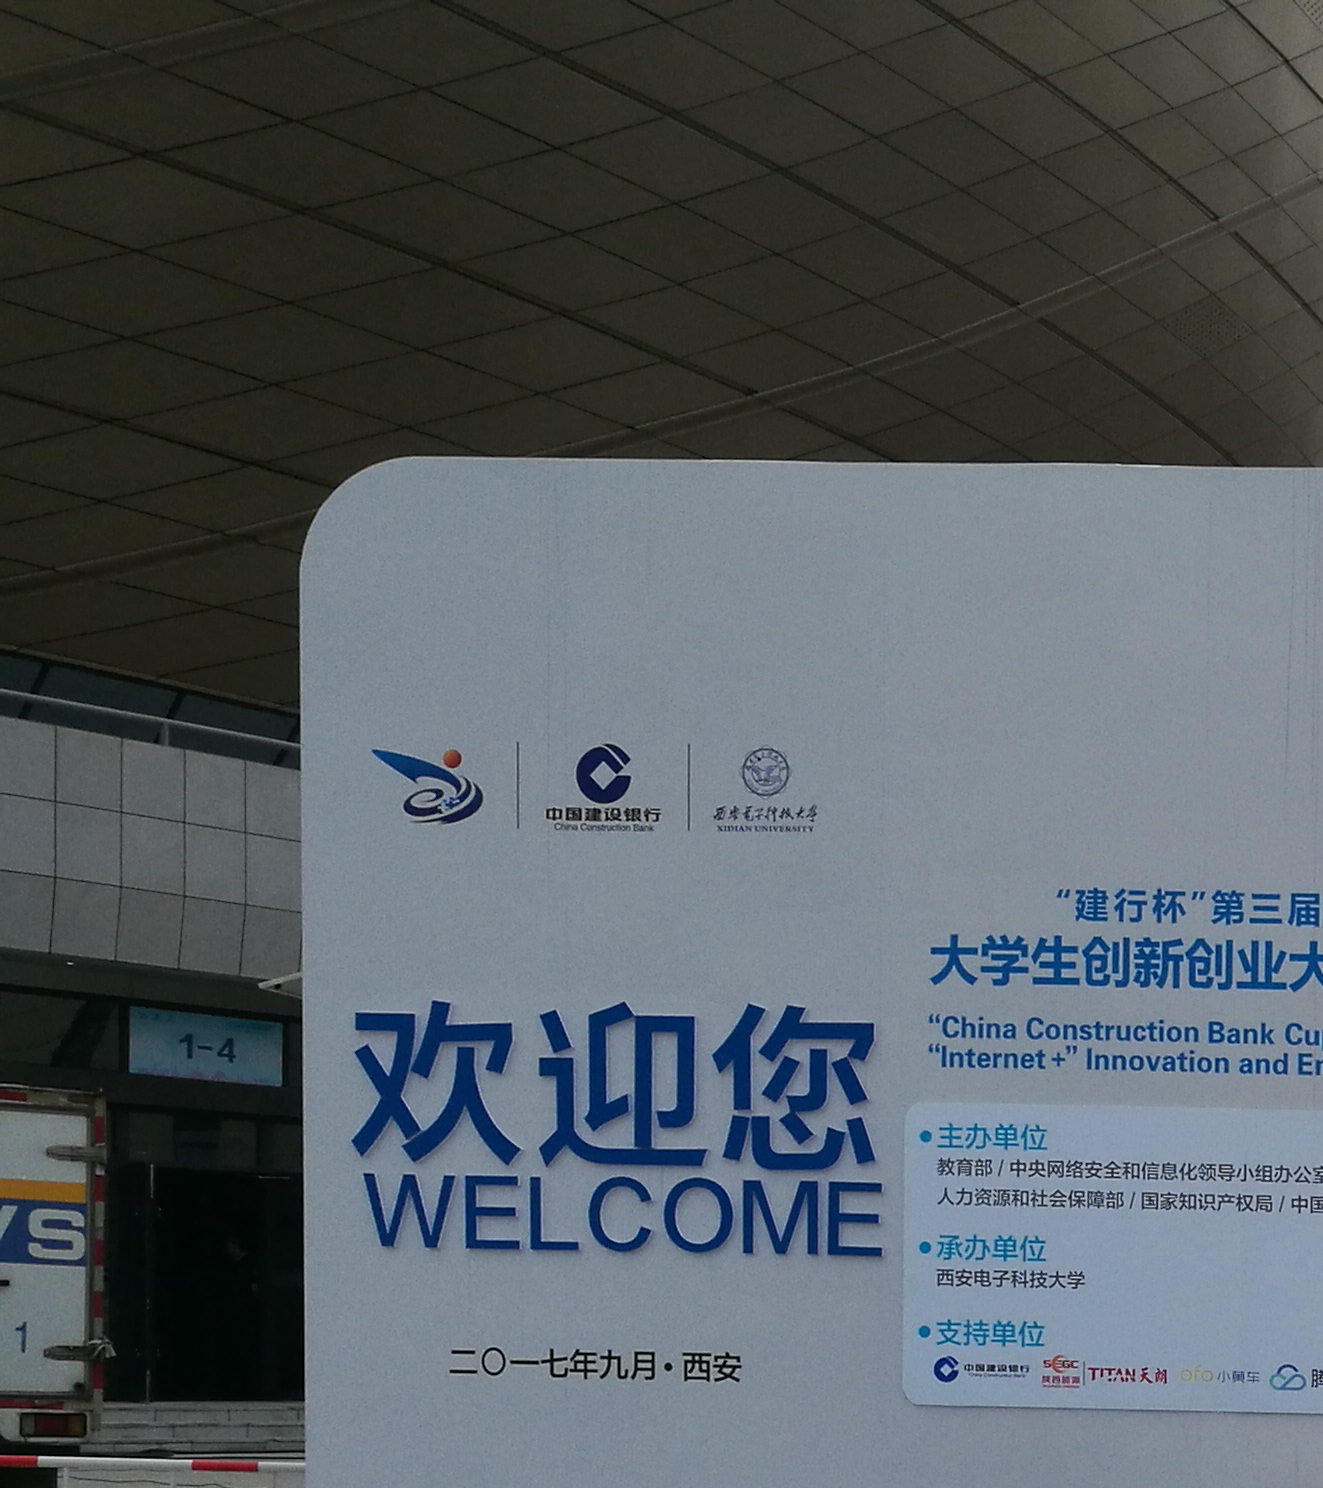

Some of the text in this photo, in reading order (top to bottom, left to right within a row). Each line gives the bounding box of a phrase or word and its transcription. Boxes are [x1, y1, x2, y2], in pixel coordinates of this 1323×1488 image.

[546, 807, 661, 823] 中国建设银行
[554, 823, 654, 833] China Construction Bank
[716, 825, 815, 833] XIDIAN UNIVERSITY
[1025, 1017, 1200, 1043] Construction
[1207, 1020, 1275, 1046] Bank
[179, 1033, 236, 1064] 1-4
[1086, 1048, 1232, 1074] Innovation
[1238, 1053, 1290, 1076] and
[351, 1000, 876, 1171] 欢迎您
[937, 1123, 1049, 1152] 主办单位
[937, 1157, 994, 1178] 教育部
[937, 1187, 1125, 1210] 人力资源和社会保障部
[1141, 1192, 1273, 1213] 国家知识产权局
[362, 1171, 885, 1258] WELCOME
[936, 1235, 1047, 1262] 承办单位
[936, 1269, 1086, 1290] 西安电子科技大学
[15, 1321, 28, 1354] 1
[936, 1319, 1046, 1348] 支持单位
[1087, 1367, 1136, 1383] TITAN
[1217, 1370, 1260, 1383] 小黄车
